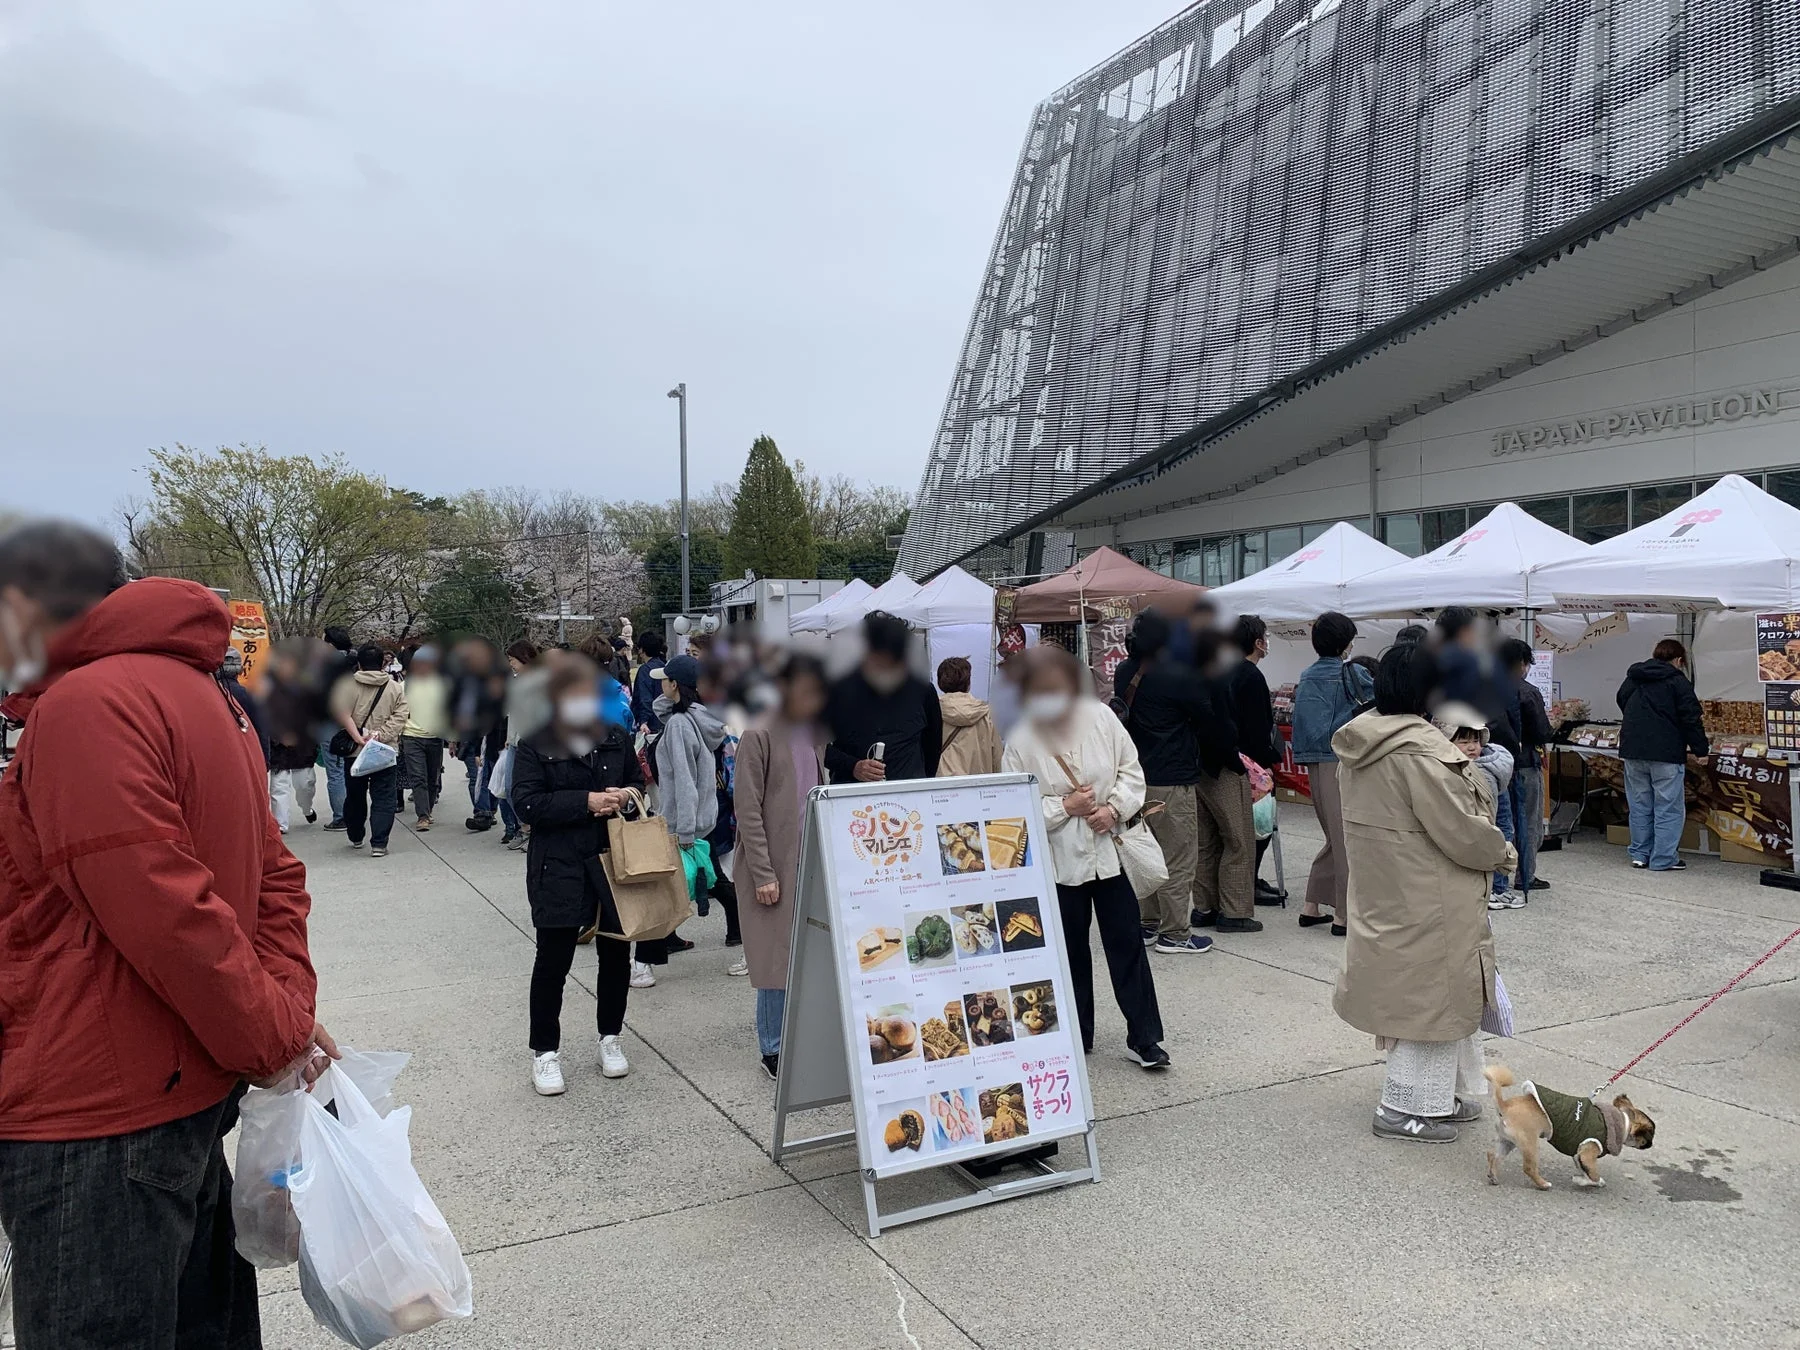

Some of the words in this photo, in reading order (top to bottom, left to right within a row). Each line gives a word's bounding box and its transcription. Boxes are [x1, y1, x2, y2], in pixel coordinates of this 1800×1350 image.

[1490, 418, 1594, 458] JAPAN
[1604, 389, 1780, 441] PAVILION
[868, 812, 908, 837] パン
[862, 836, 912, 854] マルシェ
[1027, 1069, 1069, 1097] サクラ
[1033, 1091, 1072, 1119] まつり
